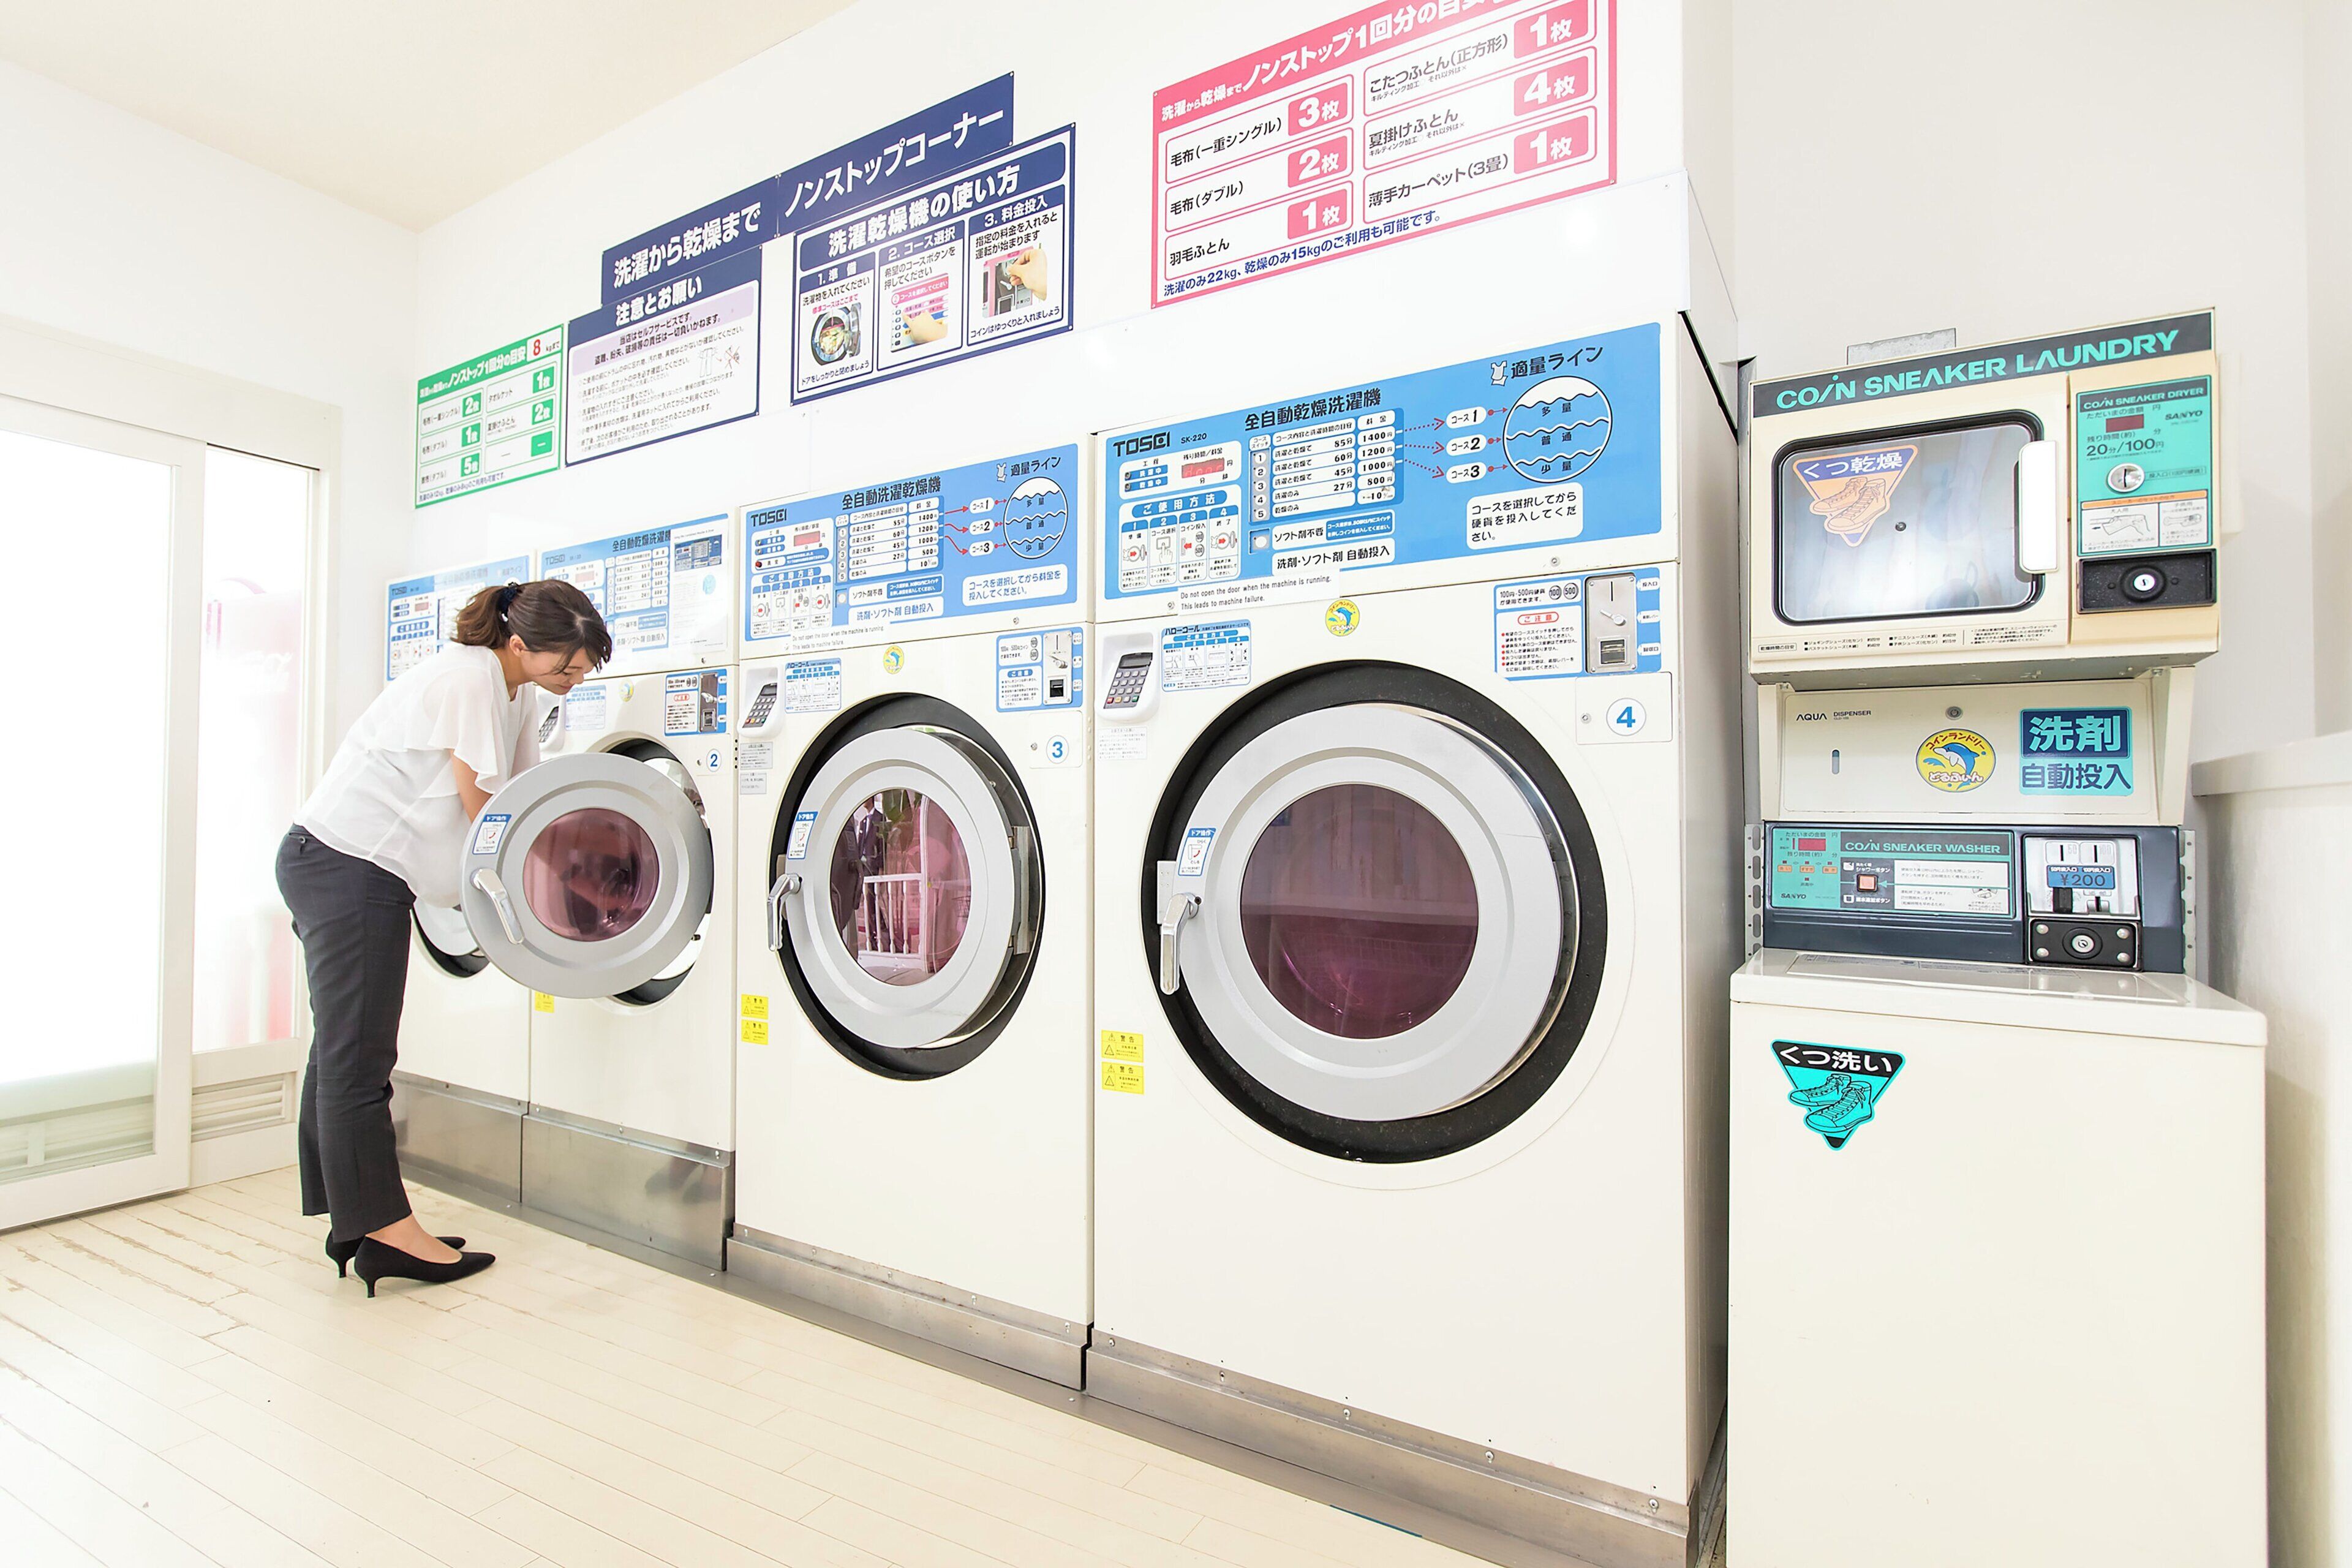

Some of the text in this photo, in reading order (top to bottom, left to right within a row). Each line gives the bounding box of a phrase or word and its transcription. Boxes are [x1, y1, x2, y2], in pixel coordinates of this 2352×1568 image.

[1530, 13, 1572, 48] 1枚
[1370, 34, 1508, 92] こたつふとん(正方形)
[1523, 71, 1575, 105] 4枚
[1298, 97, 1340, 127] 3枚
[1369, 109, 1458, 149] 夏掛けふとん
[1170, 118, 1281, 167] 毛布(一重シングル)
[1530, 131, 1572, 164] 1枚
[1298, 149, 1340, 181] 2枚
[1369, 154, 1508, 208] 薄手カーペット(3畳)
[614, 108, 1004, 288] 洗濯から乾燥まで ノンストップコーナー
[828, 164, 1020, 258] 洗濯乾燥機の使い方
[1170, 181, 1243, 215] 毛布(ダブル)
[1302, 201, 1340, 231] 1枚
[904, 226, 956, 255] コース選択
[976, 212, 1058, 247] 指定の料金を入れると
[975, 230, 1040, 260] 運転が始まります
[1170, 238, 1230, 266] 羽毛ふとん
[884, 247, 956, 278] 希望のコースボタンを
[803, 276, 870, 306] 洗濯物を入れてください
[884, 266, 932, 290] 押してください
[616, 276, 702, 326] 注意とお願い
[533, 339, 541, 356] 8
[1510, 346, 1604, 379] 適量ライン
[1776, 329, 2179, 410] COIN SNEAKER LAUNDRY
[1245, 388, 1381, 431] 全自動乾燥洗濯機
[2084, 387, 2204, 410] COIN SNEAKER DRYER
[2165, 410, 2203, 421] SANYO
[1113, 431, 1170, 457] TOSEI
[1181, 433, 1207, 444] SK-220
[2086, 439, 2165, 457] 20分/100円
[1011, 457, 1061, 477] 適量ライン
[1804, 452, 1903, 478] くつ乾燥
[842, 476, 941, 510] 全自動洗濯乾燥機
[1143, 494, 1215, 514] ご使用方法
[1471, 492, 1577, 516] コースを選択してから
[750, 508, 787, 527] TOSEI
[1190, 513, 1196, 521] 3
[1471, 506, 1577, 529] 硬貨を投入してくだ
[1471, 531, 1496, 543] さい。
[1347, 545, 1390, 560] 自動投入
[969, 587, 1027, 601] 投入してください。
[1272, 579, 1297, 588] machine
[1306, 575, 1332, 584] running.
[1219, 597, 1243, 606] machine
[1245, 595, 1265, 603] failure.
[1165, 625, 1200, 635] ハローコール
[1616, 706, 1636, 728] 4
[1796, 713, 1828, 722] AQUA
[1925, 731, 1987, 751] コインランドリー
[2029, 715, 2122, 753] 洗剤
[710, 754, 718, 767] 2
[1052, 741, 1063, 758] 3
[2022, 762, 2132, 790] 自動投入
[1845, 839, 2000, 853] COIN SNEAKER WASHER
[2060, 874, 2106, 886] ¥200
[1779, 1046, 1893, 1072] くつ洗い
